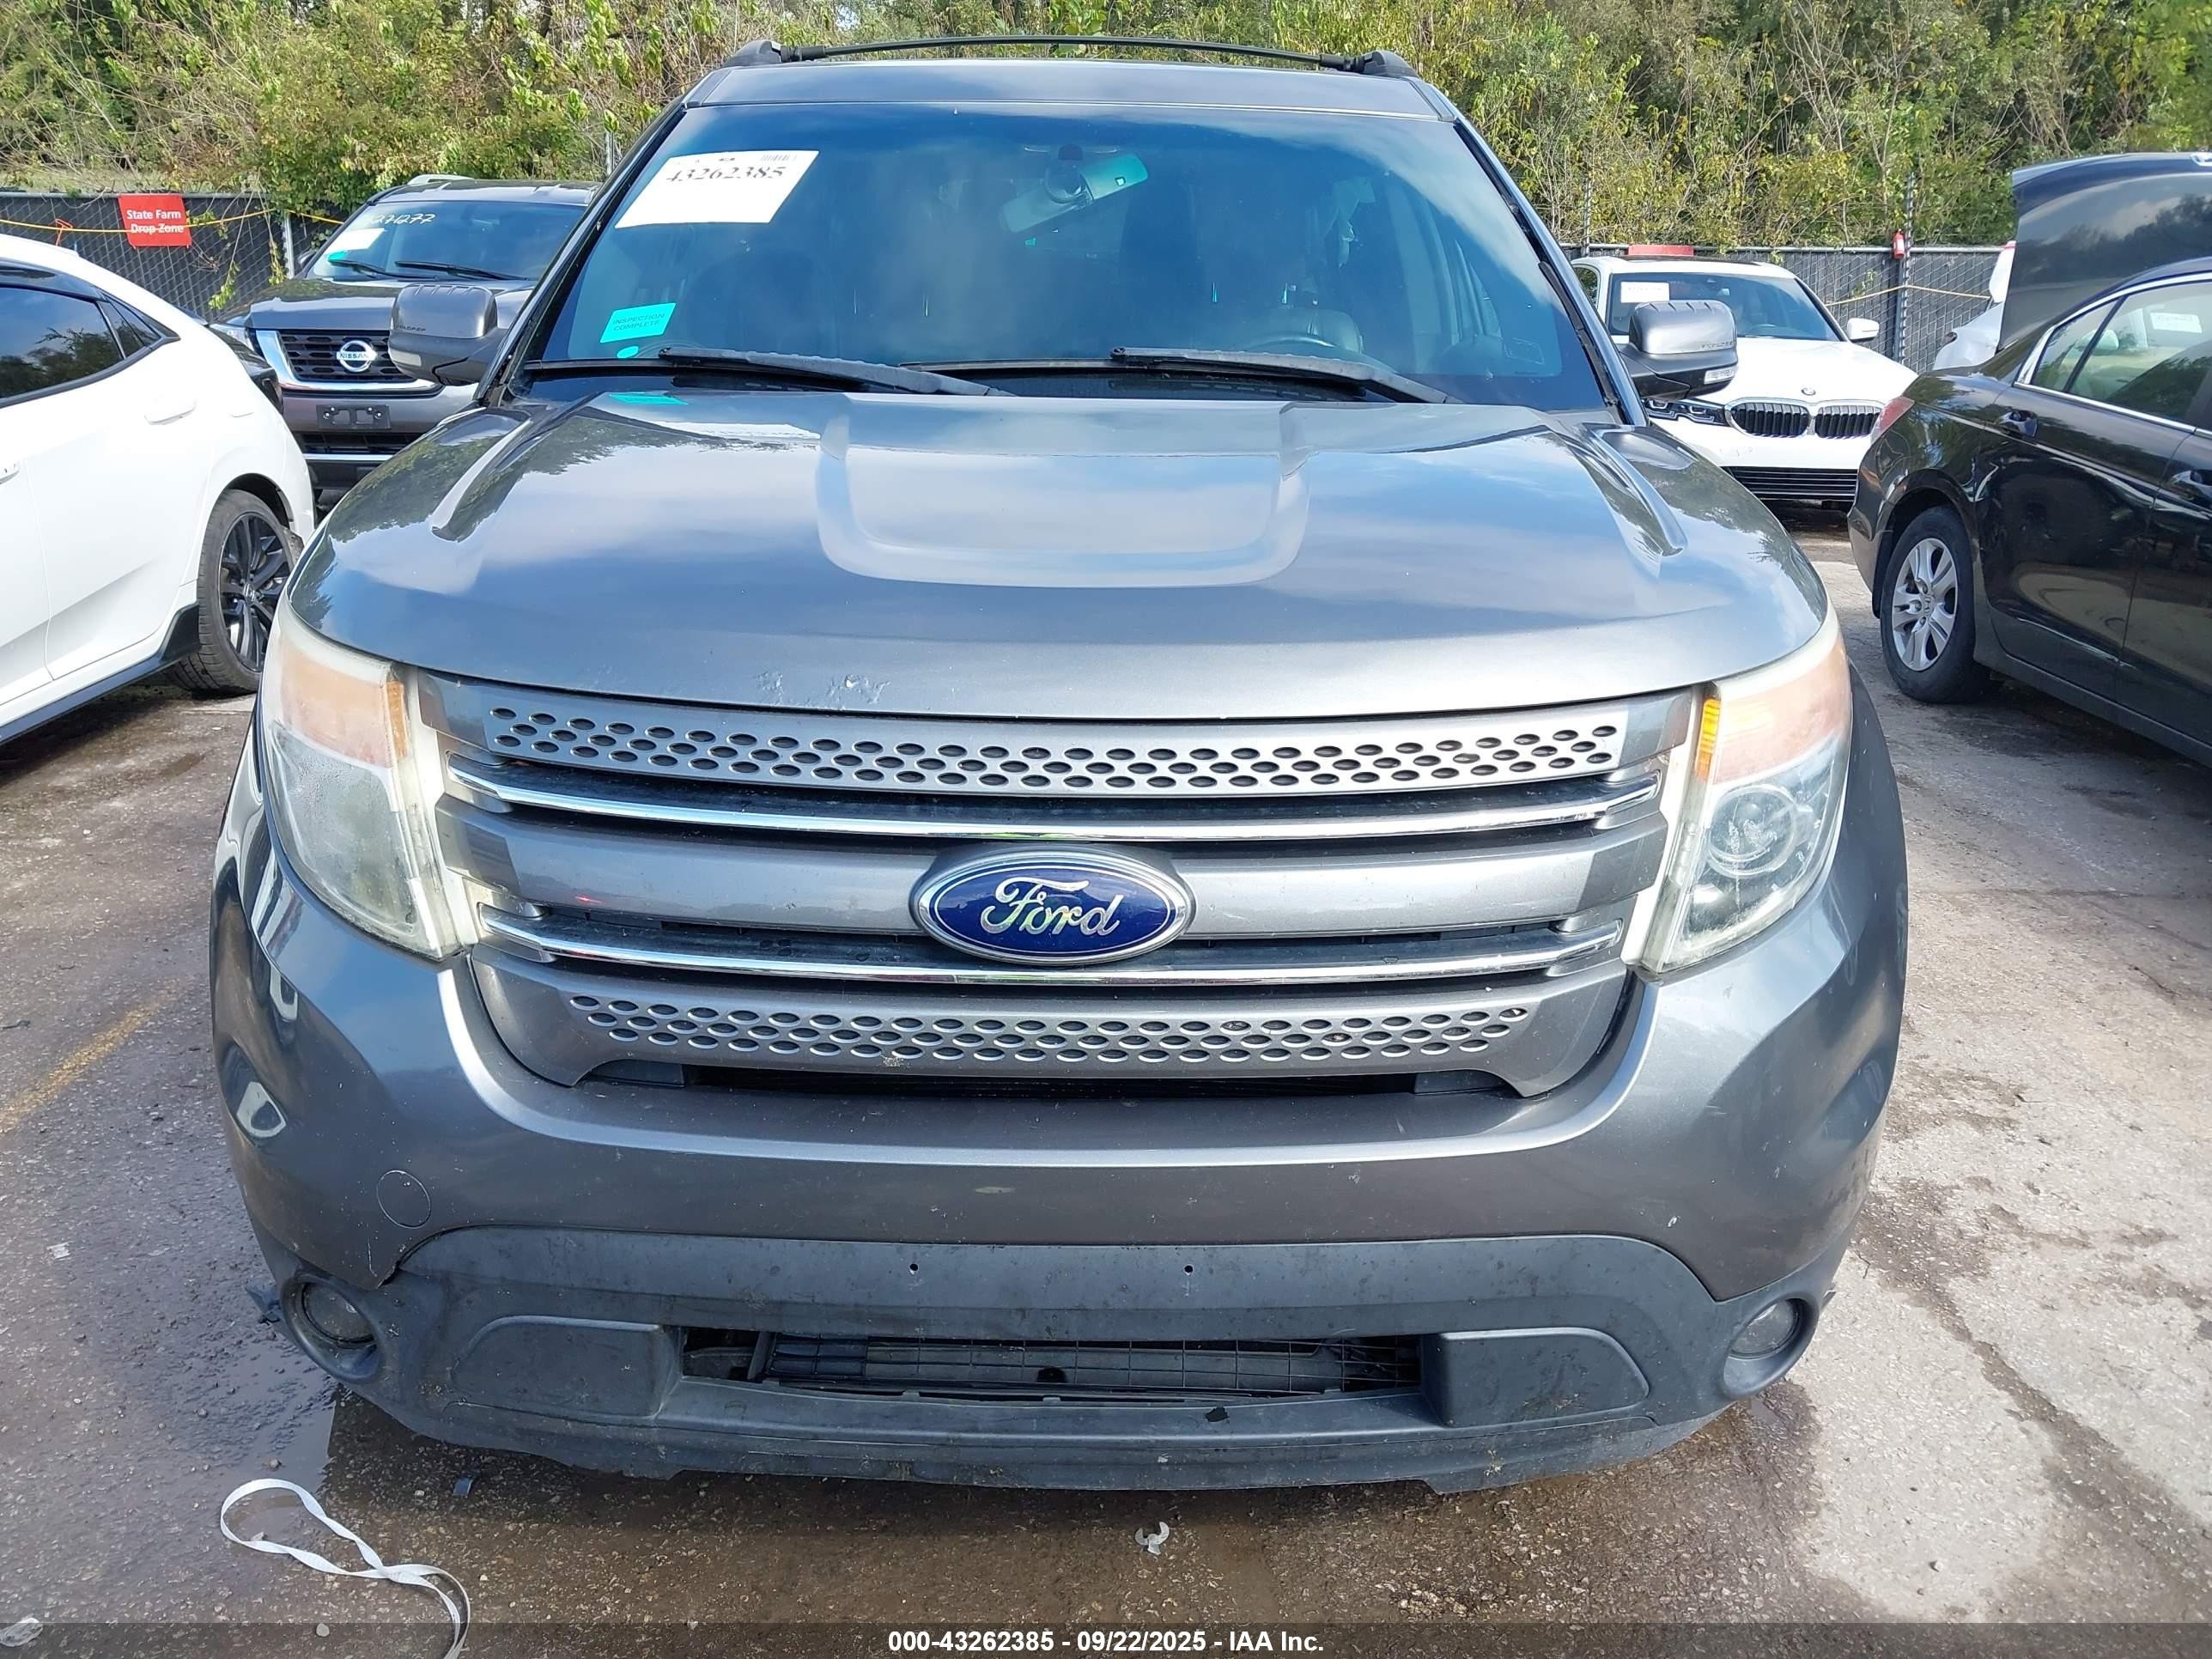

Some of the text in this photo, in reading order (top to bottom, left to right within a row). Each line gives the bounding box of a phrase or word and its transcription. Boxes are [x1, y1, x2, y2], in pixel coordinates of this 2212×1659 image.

[666, 167, 787, 182] 43262385
[126, 210, 181, 220] State Farm
[131, 223, 184, 235] Drop Zone
[613, 313, 665, 325] INSPECTION
[613, 320, 660, 331] COMPLETE
[980, 877, 1124, 936] Ford
